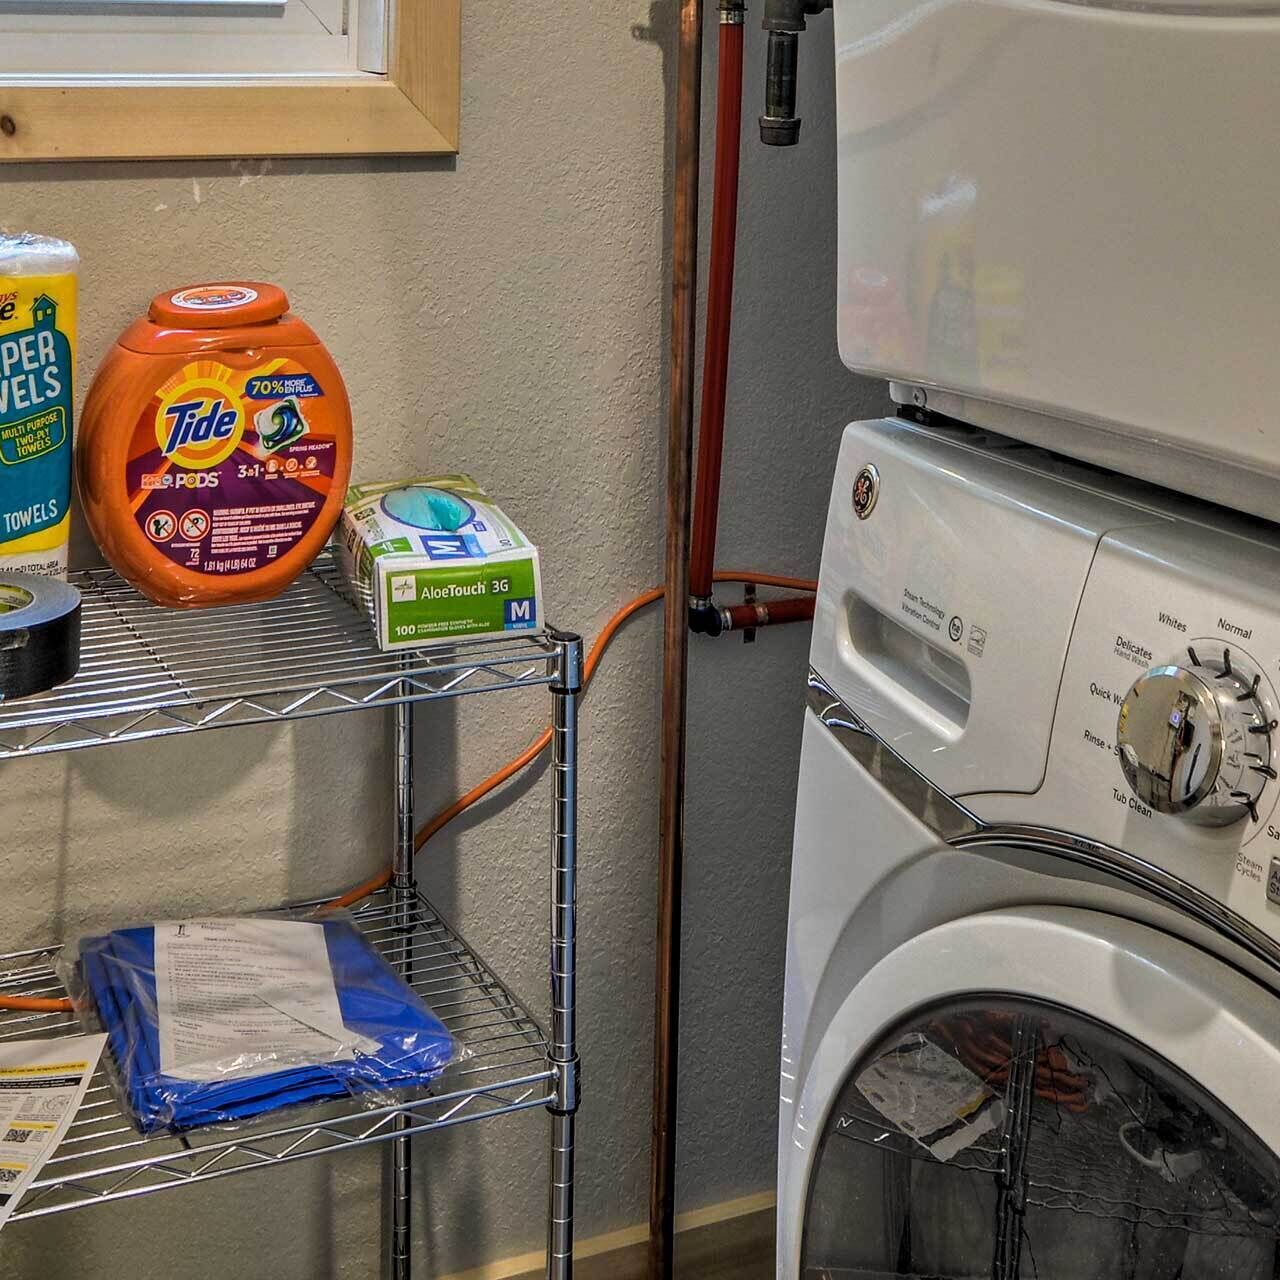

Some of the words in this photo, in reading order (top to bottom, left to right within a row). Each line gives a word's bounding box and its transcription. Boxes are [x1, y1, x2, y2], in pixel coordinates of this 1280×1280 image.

[251, 380, 284, 394] 70%
[284, 378, 305, 387] MORE
[284, 386, 296, 394] EN
[296, 384, 313, 393] PLUS
[2, 426, 26, 440] MULTI
[27, 412, 58, 432] PURPOSE
[162, 399, 239, 457] Tide
[15, 430, 50, 447] TWO-PLY
[17, 437, 51, 457] TOWELS
[176, 472, 219, 489] PODS
[4, 499, 58, 532] TOWELS
[190, 548, 200, 558] 72
[421, 581, 486, 599] AloeTouch
[492, 580, 509, 593] 3G
[511, 600, 530, 621] M
[396, 624, 416, 637] 100
[1158, 612, 1188, 633] Whites
[1217, 617, 1253, 640] Normal
[1116, 636, 1153, 661] Delicates
[1090, 682, 1112, 700] Quick
[1084, 730, 1106, 750] Rinse
[1112, 788, 1128, 806] Tub
[1128, 796, 1153, 819] Clean
[1237, 852, 1263, 872] Steam
[1236, 862, 1262, 883] Cycles
